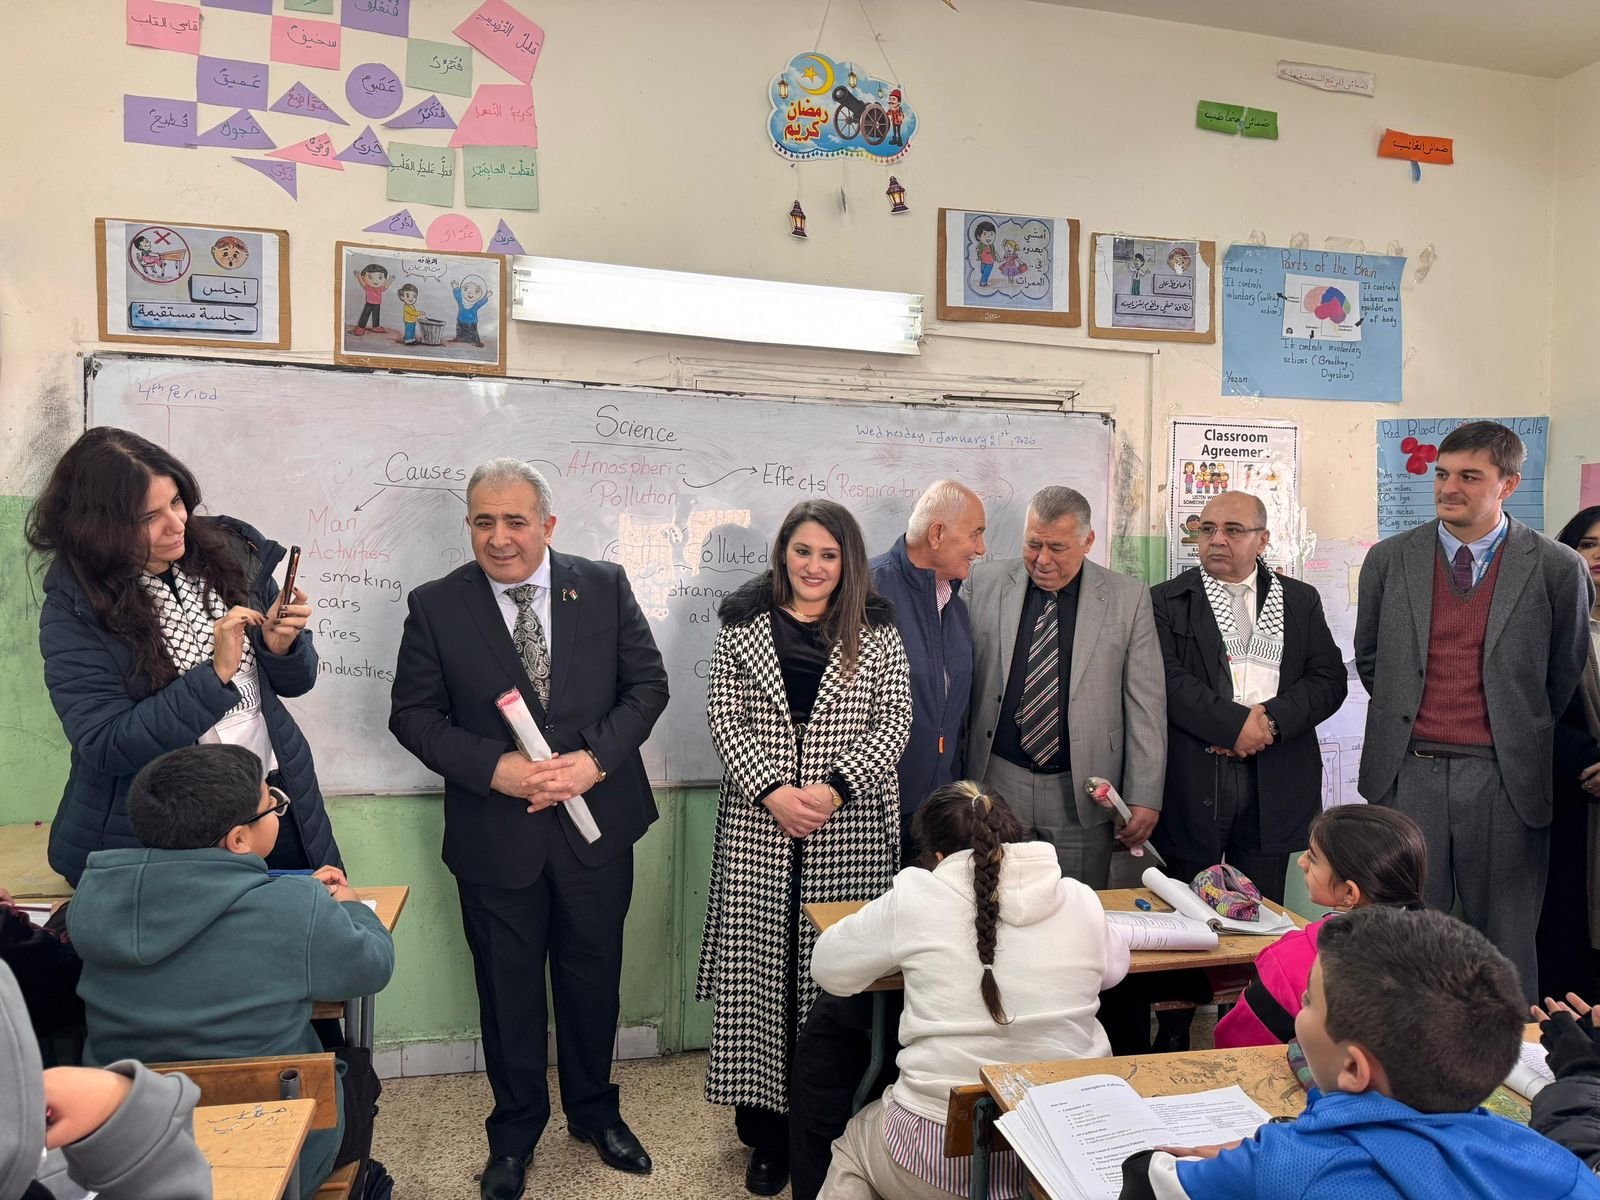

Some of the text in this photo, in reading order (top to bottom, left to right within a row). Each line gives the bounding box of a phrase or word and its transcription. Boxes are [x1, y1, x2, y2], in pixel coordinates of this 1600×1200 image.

[787, 99, 829, 124] رمضان
[784, 120, 822, 142] كريم
[1280, 250, 1378, 279] Parts of the Brain
[203, 281, 247, 298] أجلس
[136, 304, 245, 325] جلسة مستقيمة
[168, 384, 218, 401] Period
[596, 404, 677, 442] Science
[1382, 420, 1401, 439] Red
[1407, 419, 1436, 437] Blood
[1518, 418, 1543, 436] Cells
[931, 430, 987, 450] January
[1204, 429, 1268, 443] Classroom
[385, 452, 467, 483] Causes
[566, 449, 687, 480] Atmospheric
[763, 462, 826, 492] Effects
[590, 480, 680, 508] Pollution
[307, 505, 357, 537] Man
[308, 538, 391, 564] Activities
[319, 569, 403, 603] smoking
[318, 597, 361, 612] cars
[318, 619, 361, 643] fires
[318, 656, 395, 684] industries
